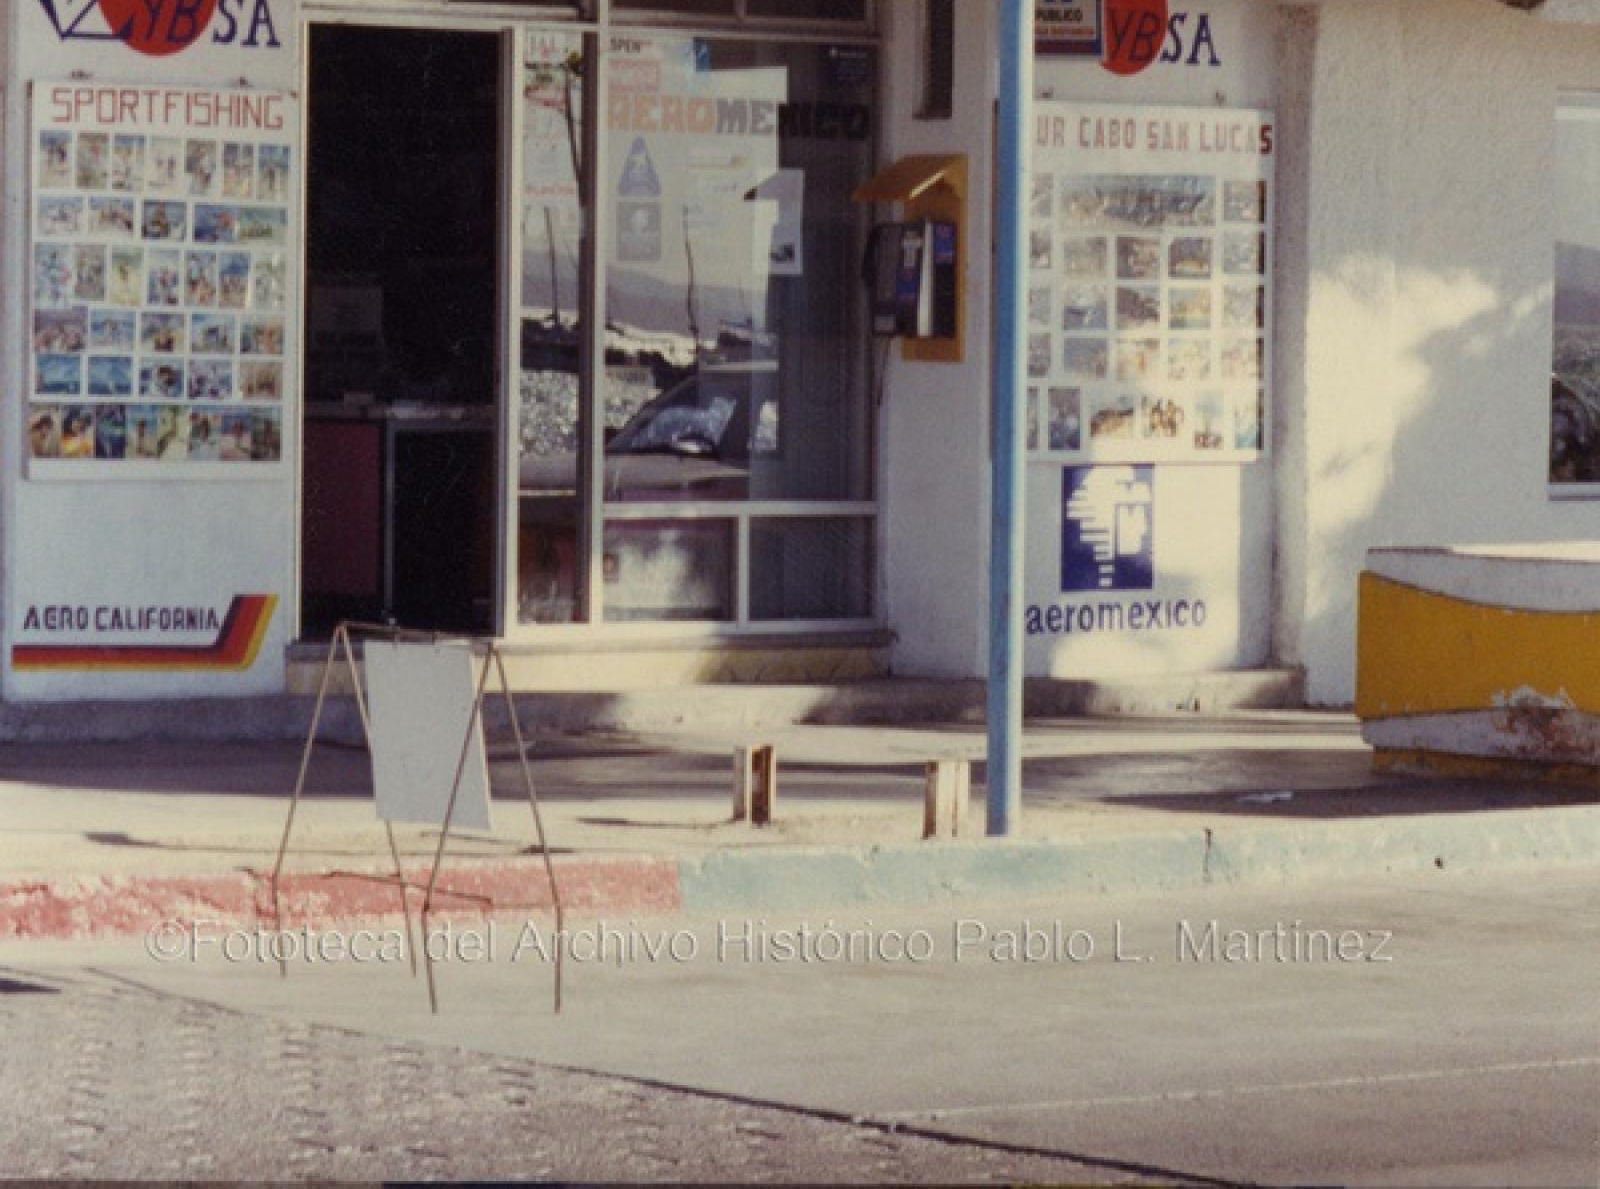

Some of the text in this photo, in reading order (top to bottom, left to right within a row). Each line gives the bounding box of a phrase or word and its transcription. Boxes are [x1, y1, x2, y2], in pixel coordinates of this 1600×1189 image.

[52, 87, 284, 130] SPORTFISHING
[1079, 117, 1136, 150] CABO
[1148, 121, 1189, 151] SAN
[1199, 124, 1272, 154] LUCAS
[95, 606, 219, 631] CALIFORNIA
[1025, 599, 1206, 635] aeromexico
